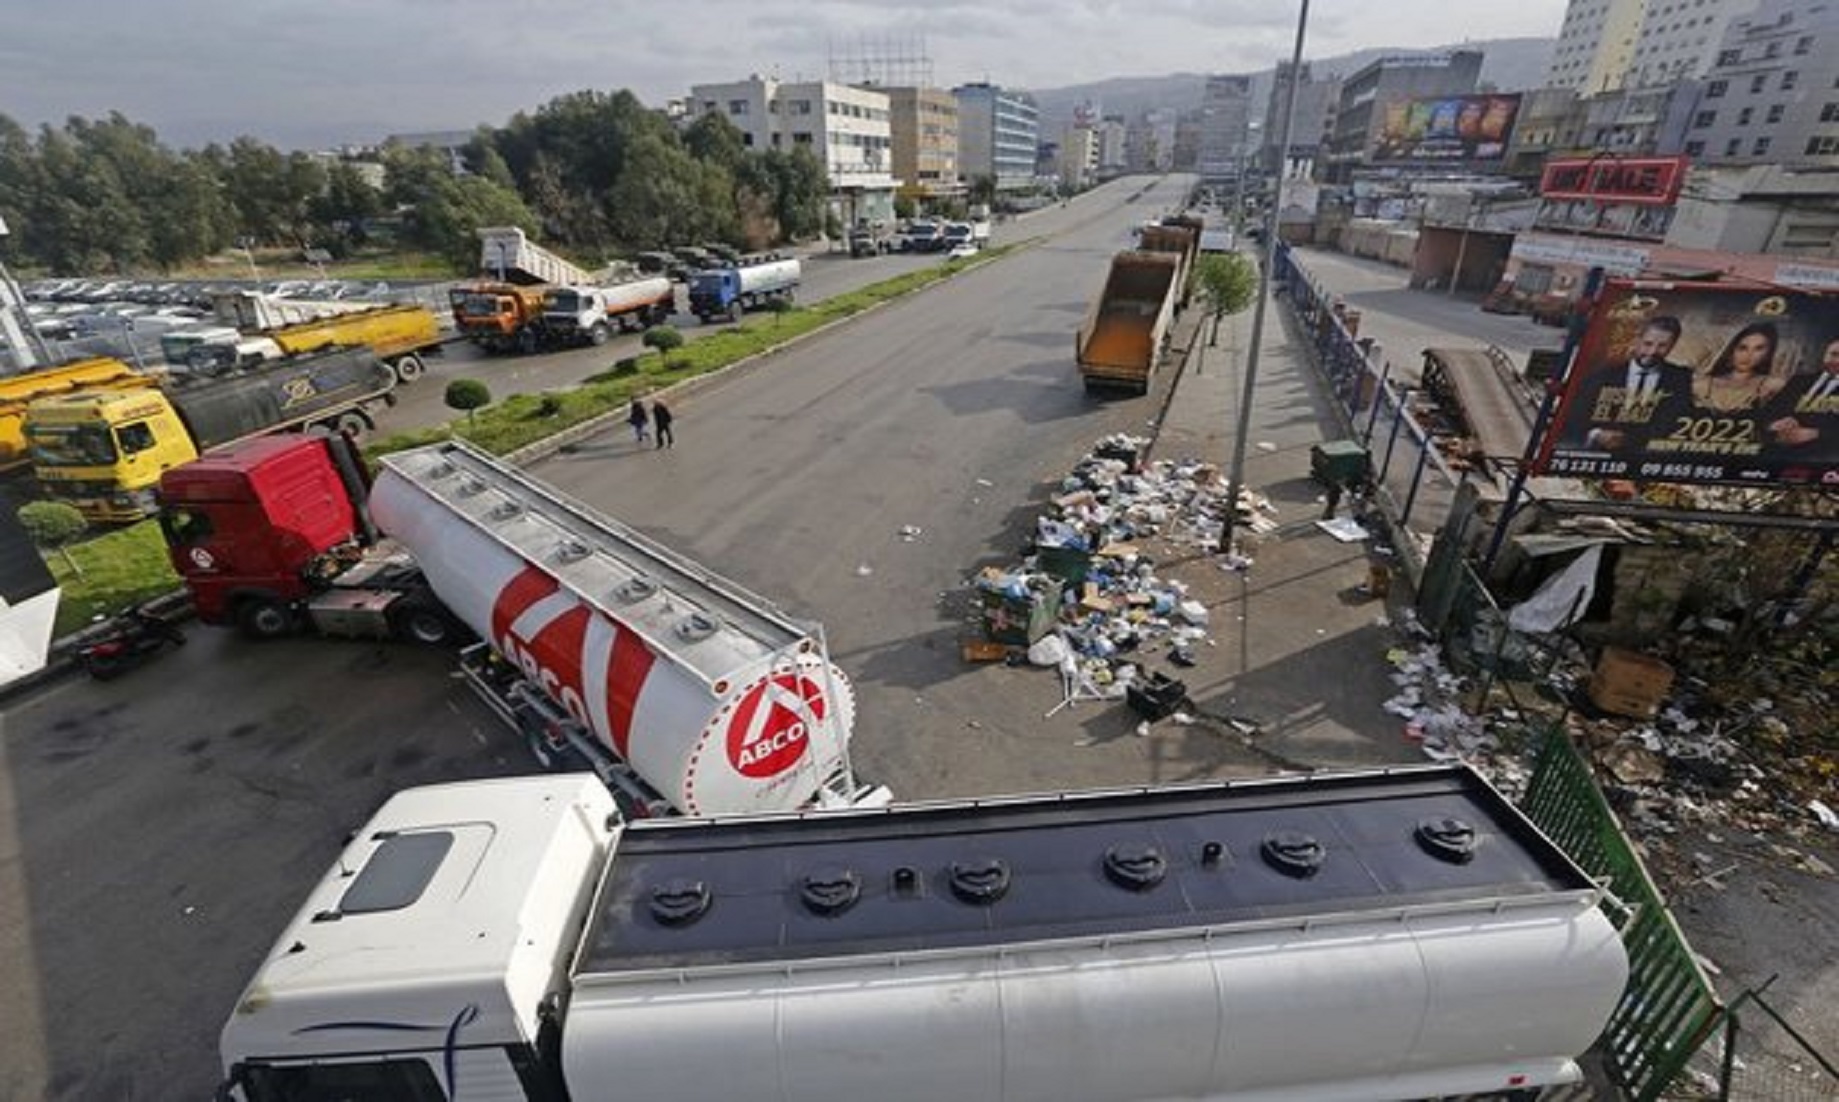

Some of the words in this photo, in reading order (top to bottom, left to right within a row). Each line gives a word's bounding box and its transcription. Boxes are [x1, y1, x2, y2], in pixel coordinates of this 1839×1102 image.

[1669, 416, 1755, 442] 2022
[1550, 458, 1569, 471] 76
[1599, 461, 1628, 474] 110
[1640, 462, 1662, 475] 09
[503, 633, 592, 736] ABCO
[738, 721, 805, 770] ABCO
